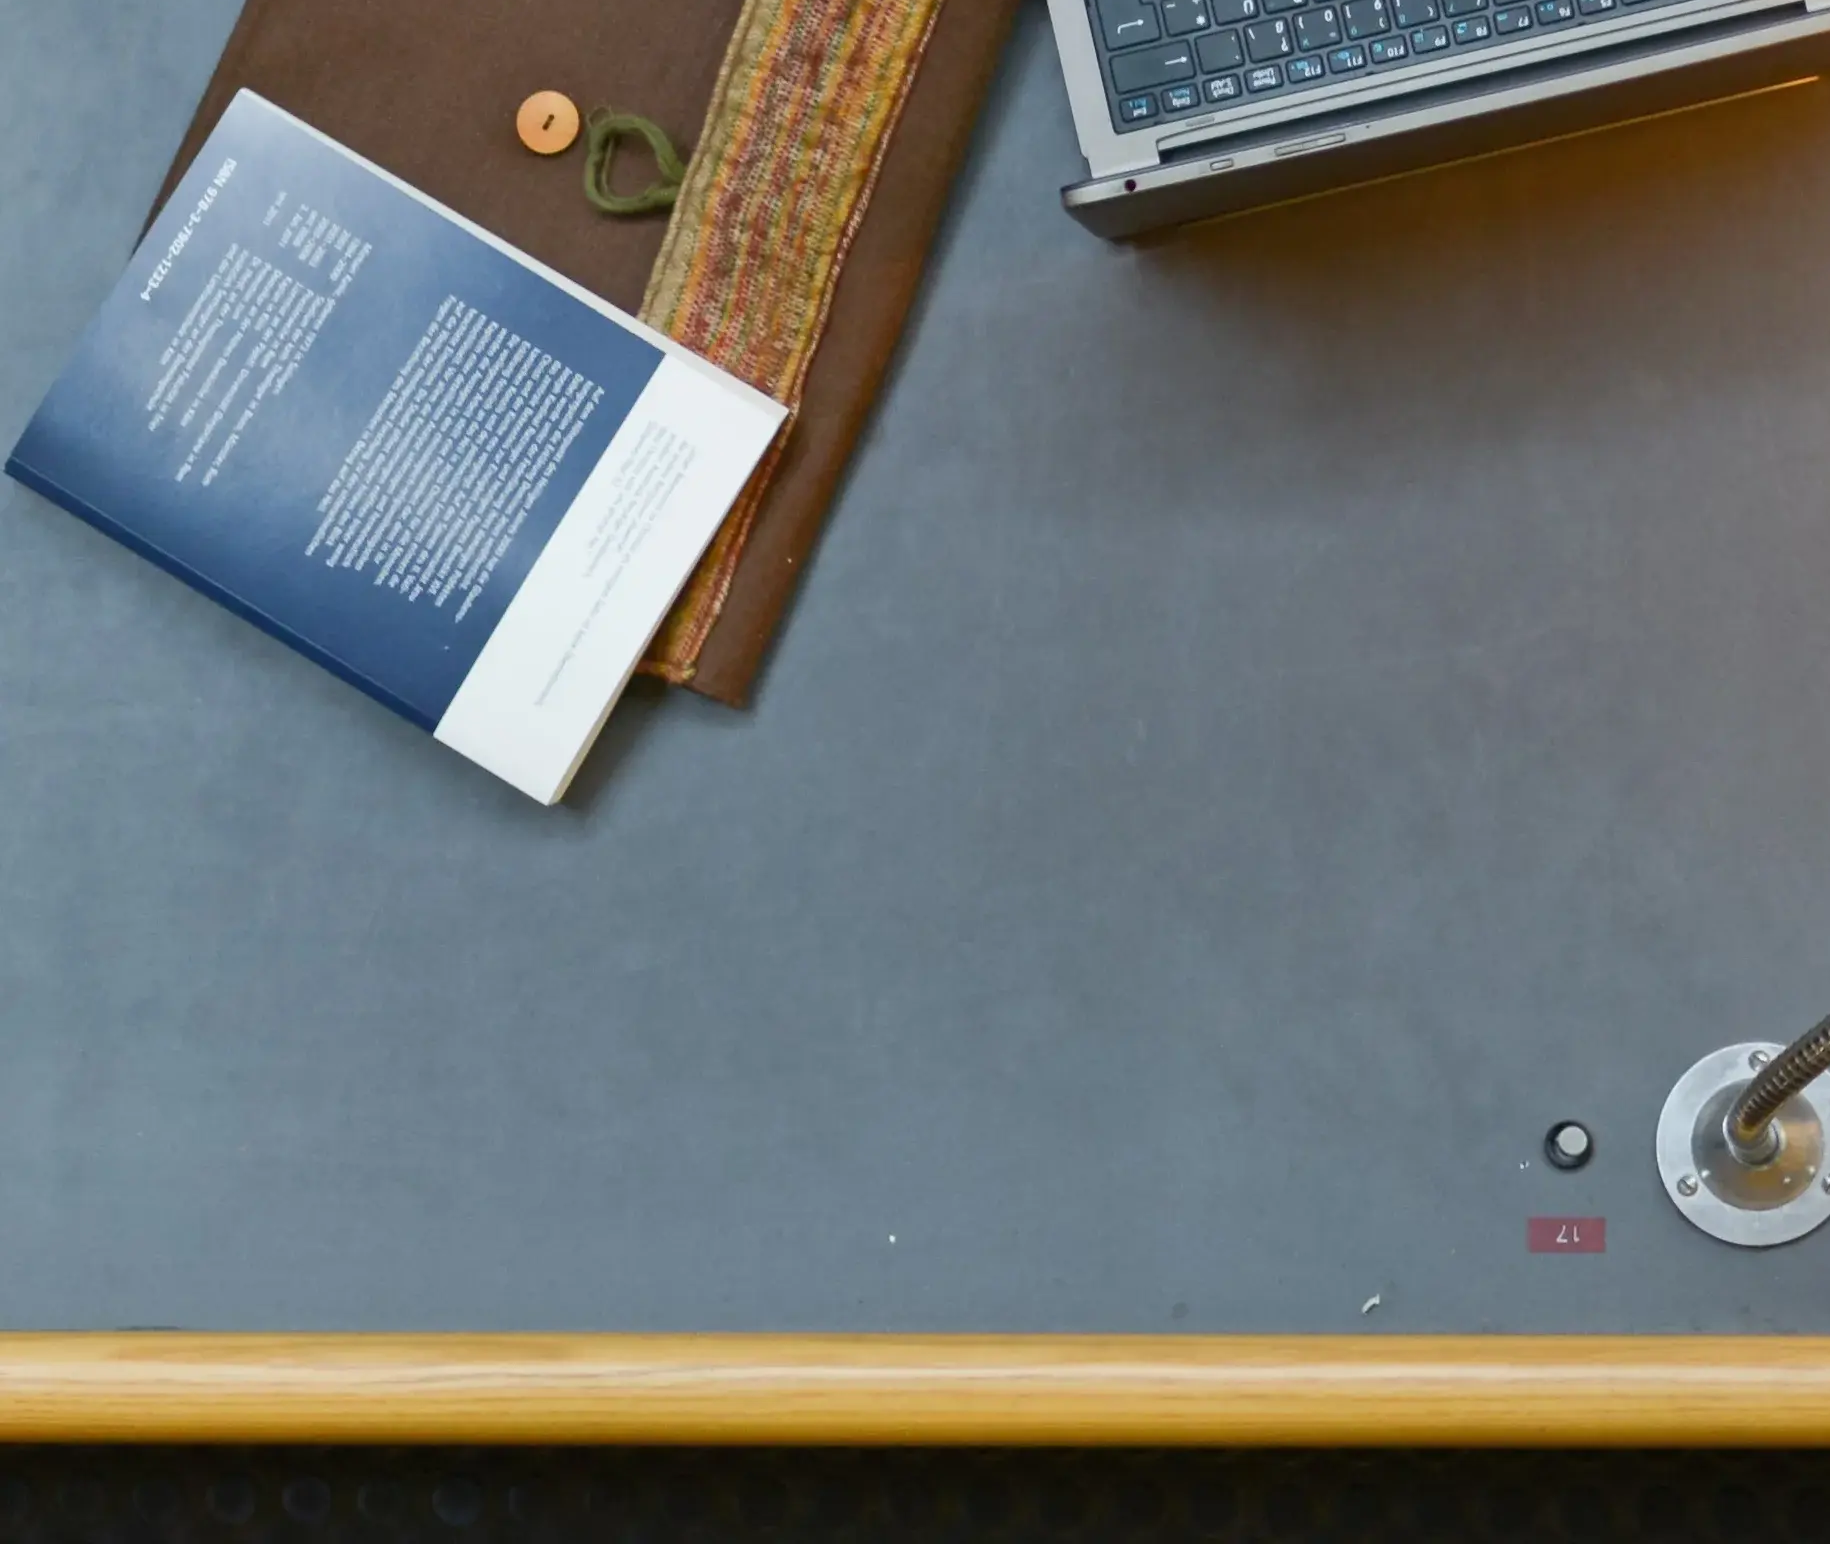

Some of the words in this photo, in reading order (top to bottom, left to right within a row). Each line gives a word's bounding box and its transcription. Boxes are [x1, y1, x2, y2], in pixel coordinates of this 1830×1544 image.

[1558, 6, 1570, 17] F6
[1517, 15, 1529, 27] F7
[1475, 25, 1487, 36] F8
[1433, 35, 1446, 46] F9
[1386, 44, 1404, 57] F10
[1346, 54, 1362, 67] F11
[1303, 64, 1321, 77] F12
[212, 157, 237, 187] ISBN
[1555, 1224, 1580, 1244] 17
